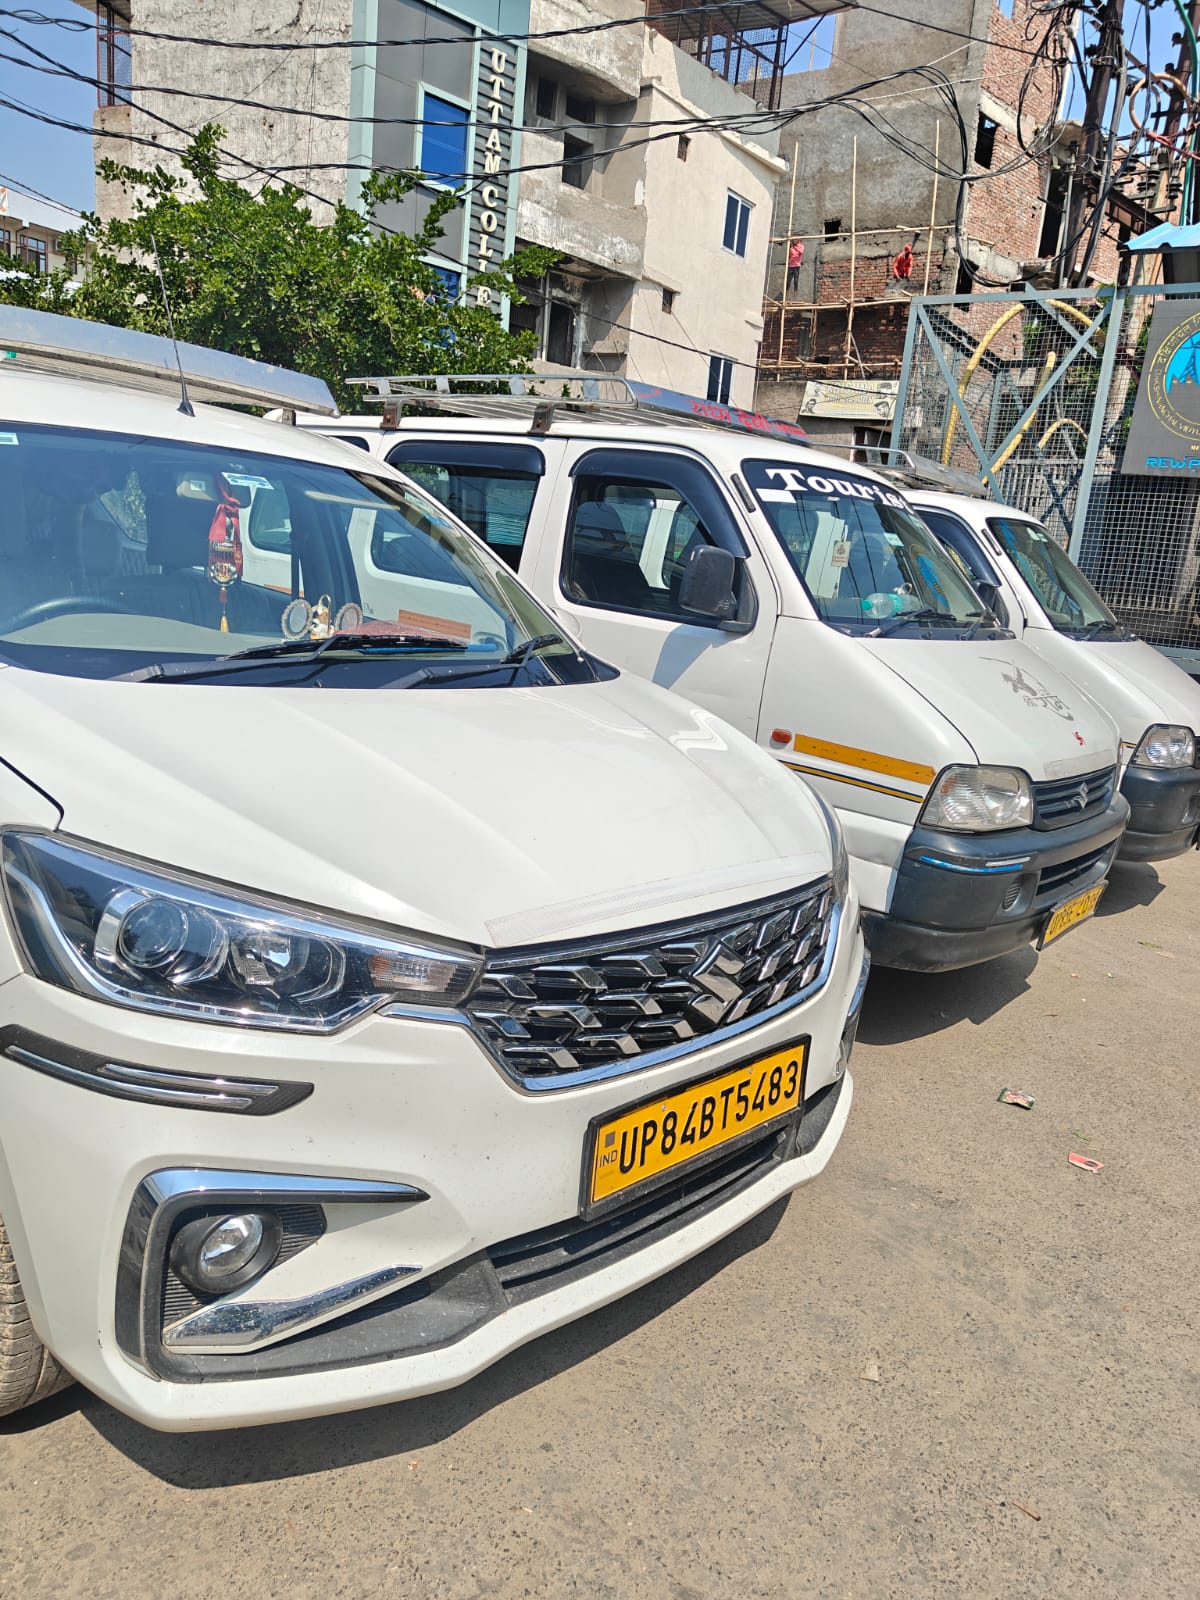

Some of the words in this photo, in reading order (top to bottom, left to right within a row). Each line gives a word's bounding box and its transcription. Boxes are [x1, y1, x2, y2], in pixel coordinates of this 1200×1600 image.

[484, 47, 507, 174] UTTAM
[600, 1149, 618, 1168] IND
[619, 1060, 799, 1174] UP84BT5483
